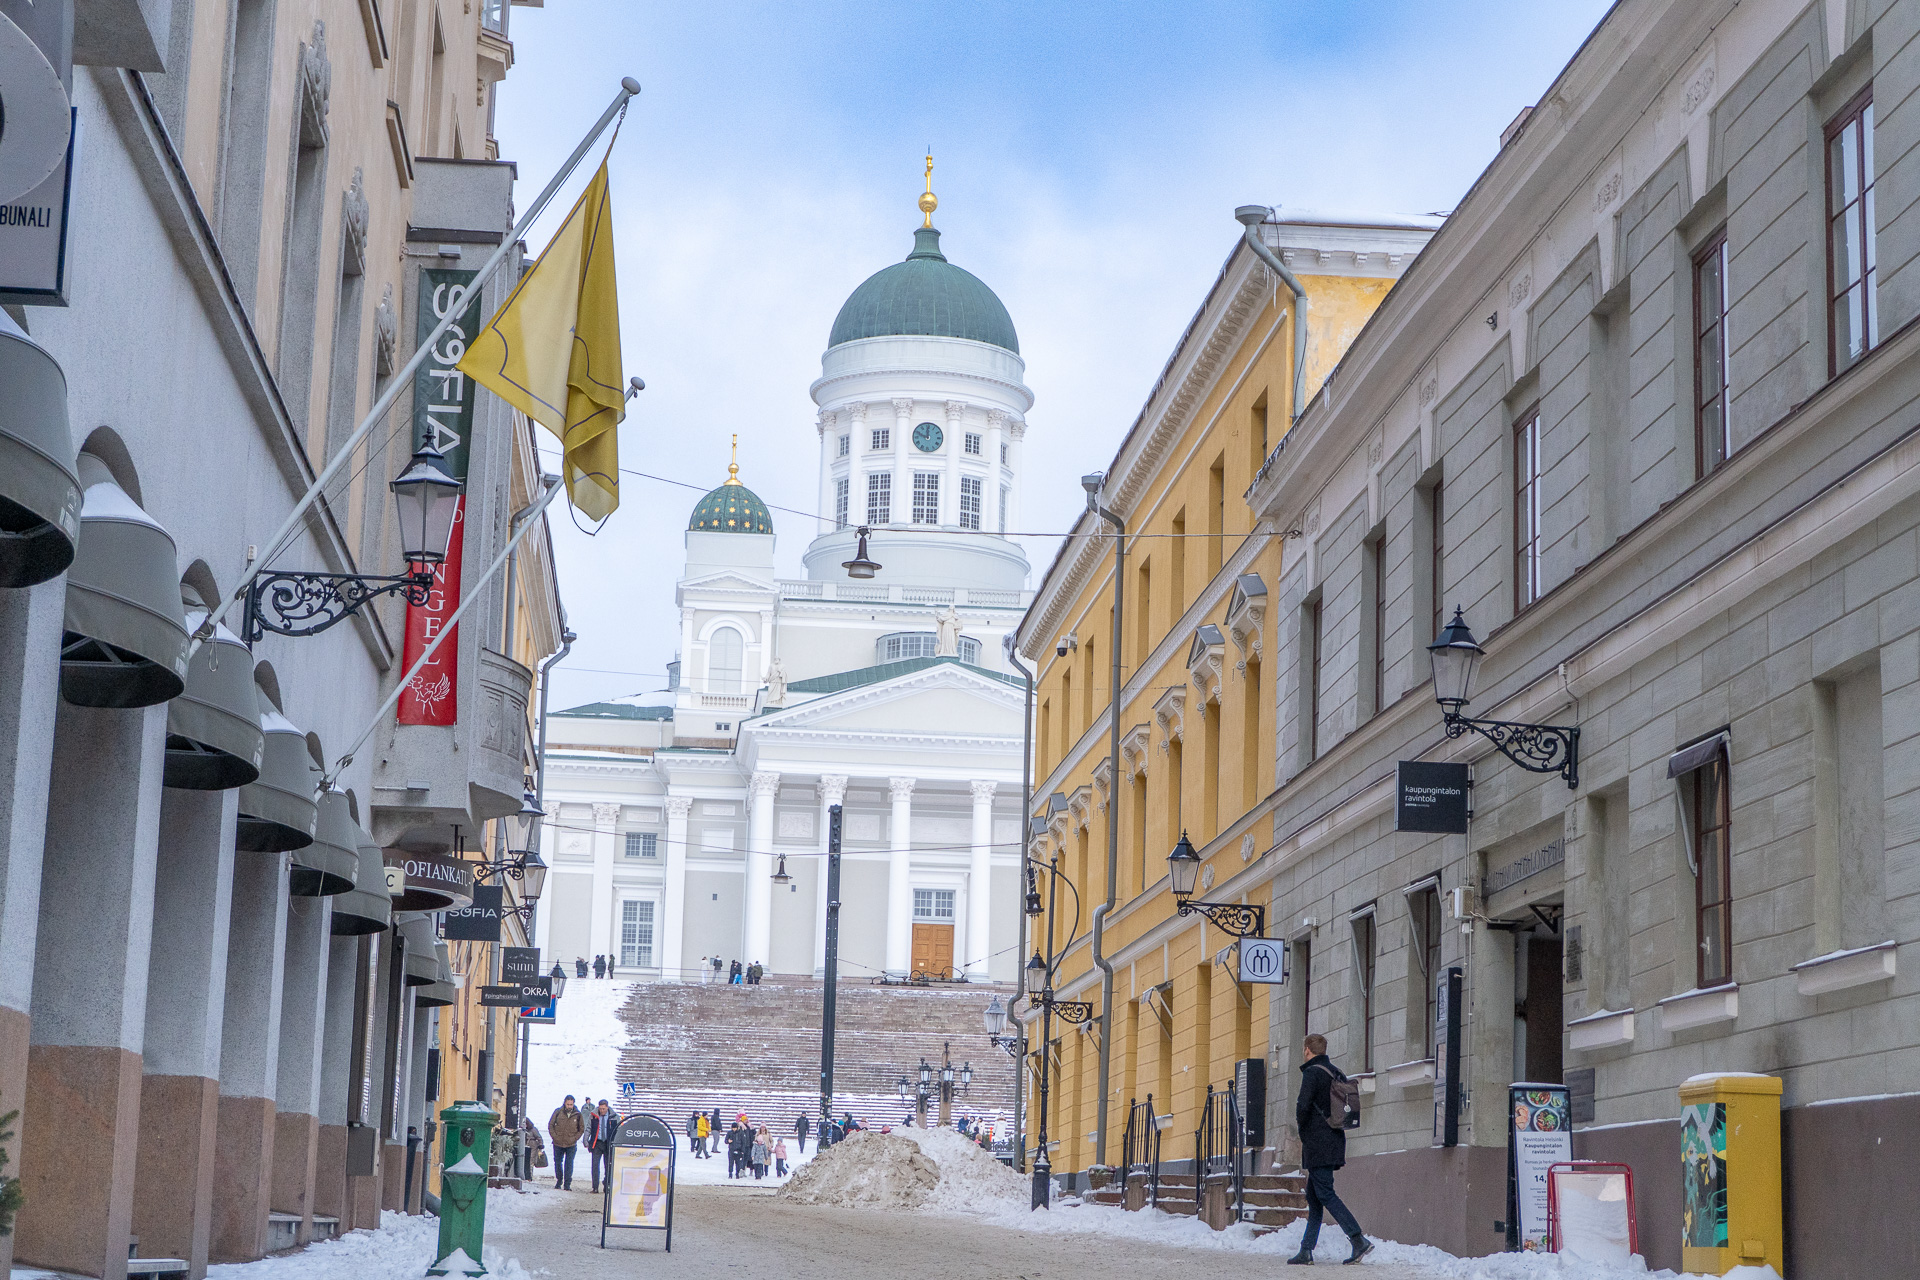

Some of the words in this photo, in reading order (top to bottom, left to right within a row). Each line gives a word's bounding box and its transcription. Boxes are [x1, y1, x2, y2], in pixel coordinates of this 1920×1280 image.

[423, 562, 450, 666] NGEL
[1405, 785, 1461, 796] kaupungintalon
[1405, 795, 1437, 803] ravintola
[449, 907, 498, 919] SOFIA
[507, 962, 535, 972] sunn
[523, 987, 548, 996] OKRA
[625, 1129, 660, 1138] SOFIA
[1534, 1174, 1547, 1184] 14,
